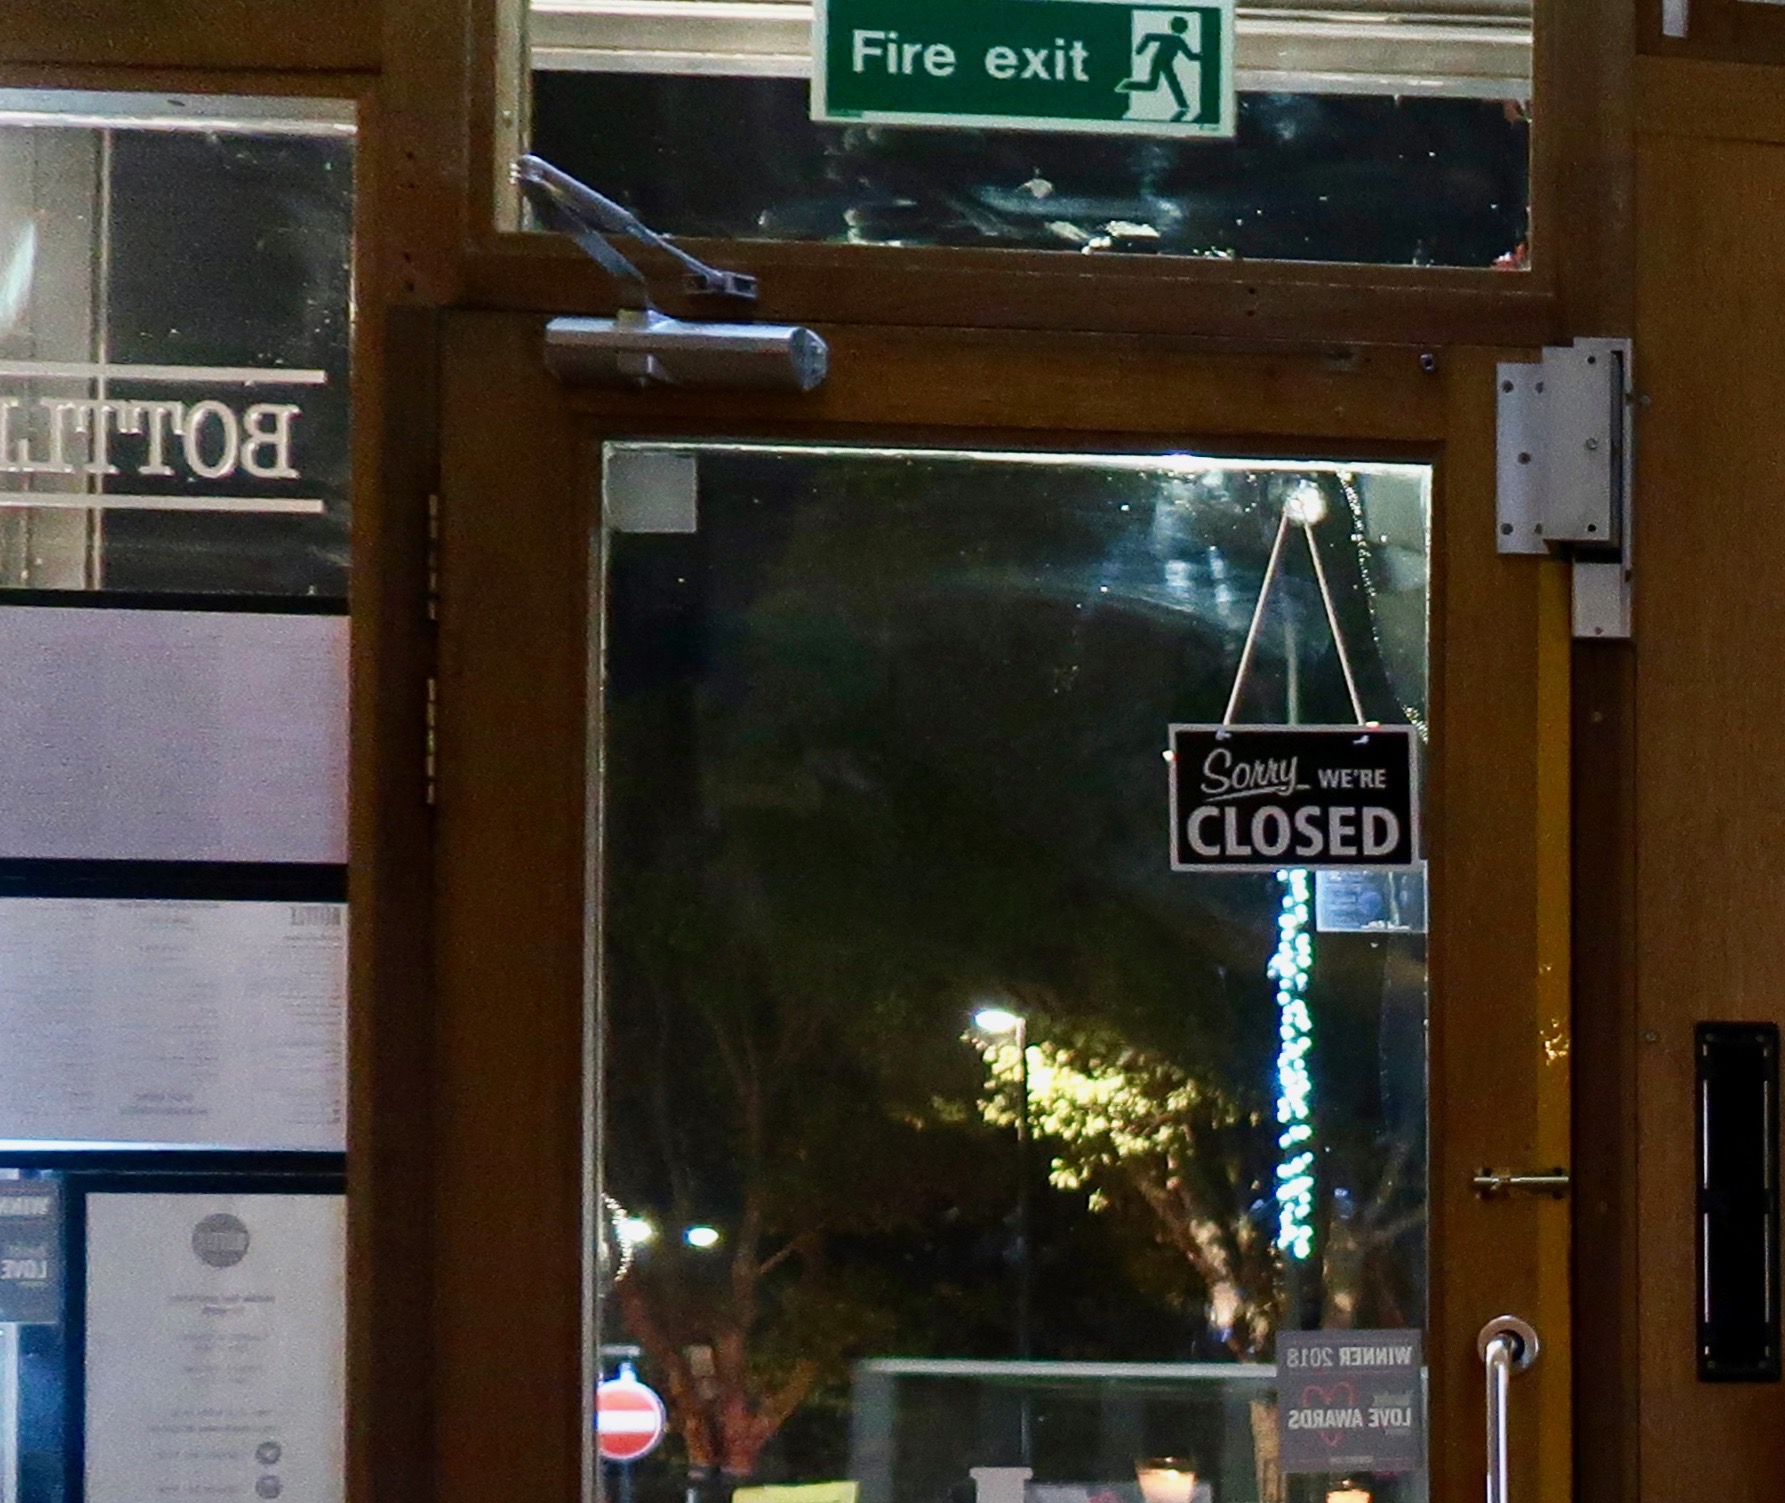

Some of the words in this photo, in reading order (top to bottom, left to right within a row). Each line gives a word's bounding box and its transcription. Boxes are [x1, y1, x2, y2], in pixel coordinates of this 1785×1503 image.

[852, 29, 957, 77] Fire
[984, 38, 1090, 83] exit
[1200, 748, 1308, 801] Sorry
[1317, 768, 1387, 789] WE'RE
[1186, 805, 1400, 857] CLOSED
